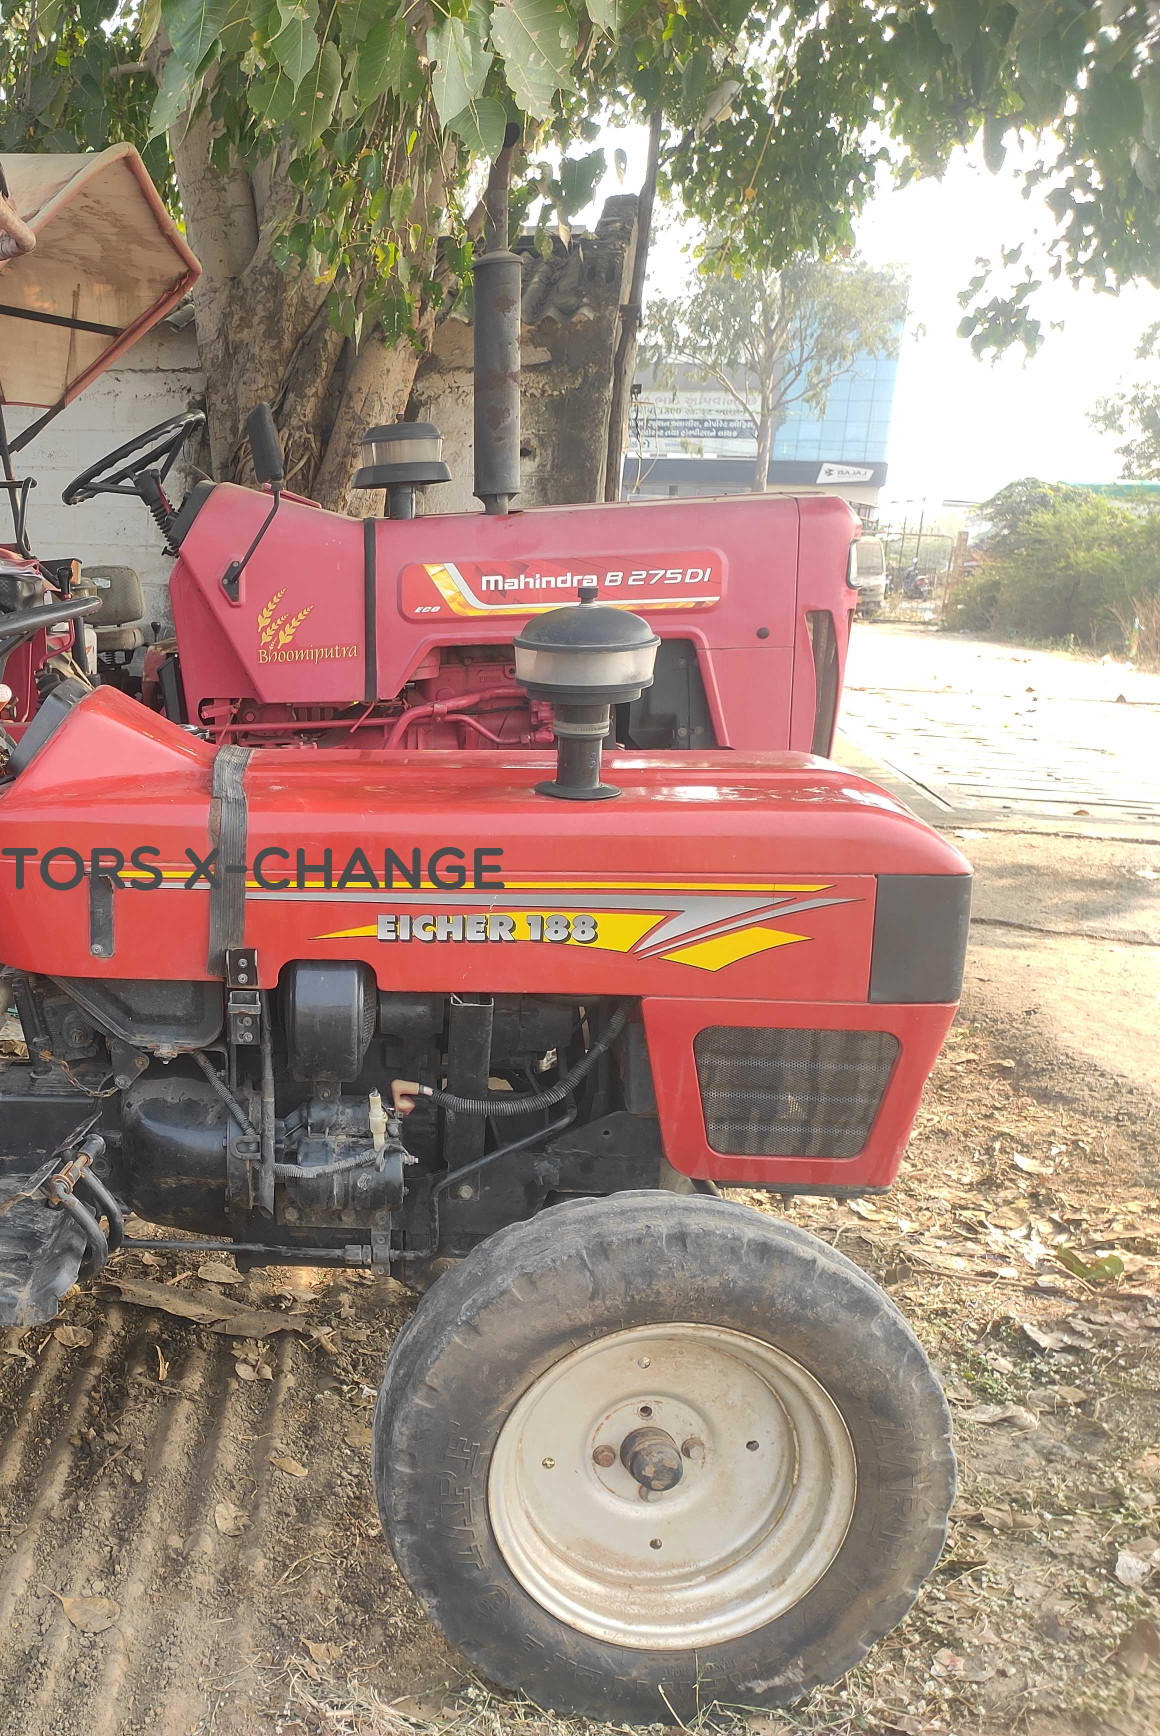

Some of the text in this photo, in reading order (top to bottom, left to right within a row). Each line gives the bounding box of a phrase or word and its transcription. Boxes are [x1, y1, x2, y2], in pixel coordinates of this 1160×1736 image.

[481, 572, 598, 592] Mahindra
[604, 571, 624, 586] B
[414, 605, 441, 614] ECO
[257, 640, 358, 667] Bhoomiputra
[377, 914, 600, 943] EICHER 188
